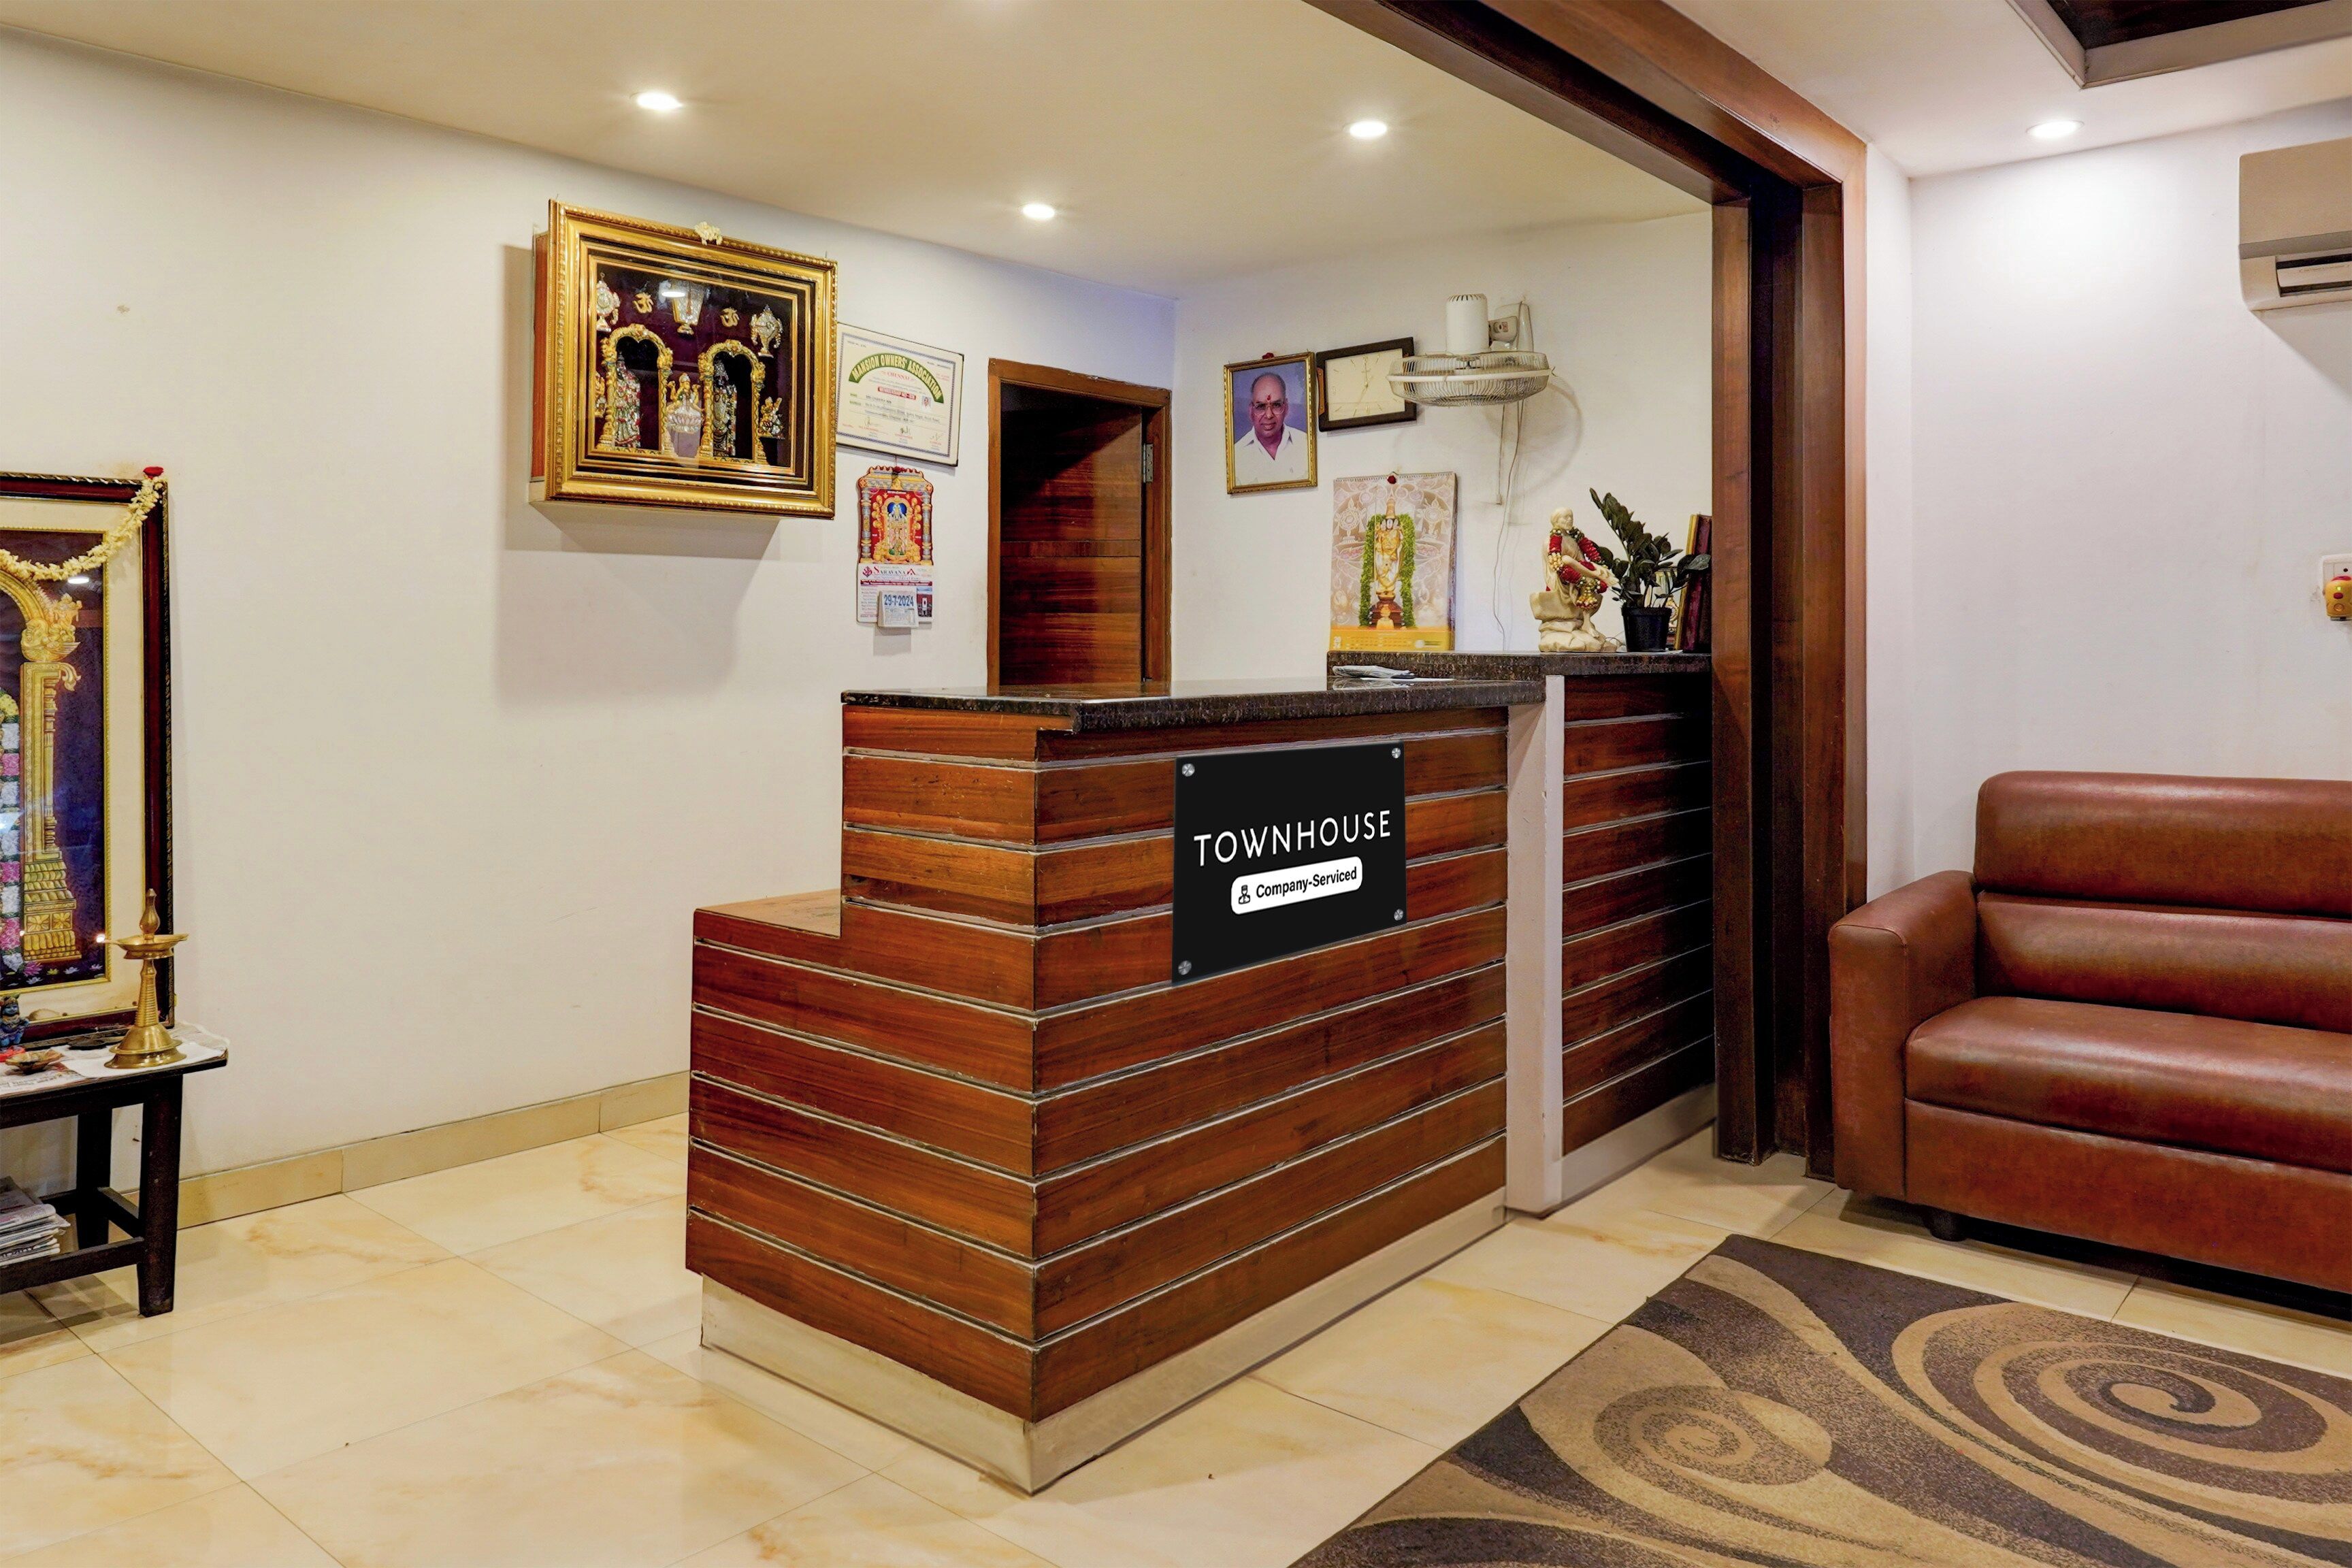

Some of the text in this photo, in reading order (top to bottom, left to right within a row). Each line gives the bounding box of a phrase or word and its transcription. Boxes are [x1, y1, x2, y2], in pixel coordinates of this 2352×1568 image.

[851, 356, 879, 380] MANSION
[907, 361, 942, 400] ASSOCIATION
[883, 594, 914, 606] 29-7-2024
[1193, 810, 1391, 866] TOWNHOUSE
[1256, 866, 1358, 899] Company-Serviced
